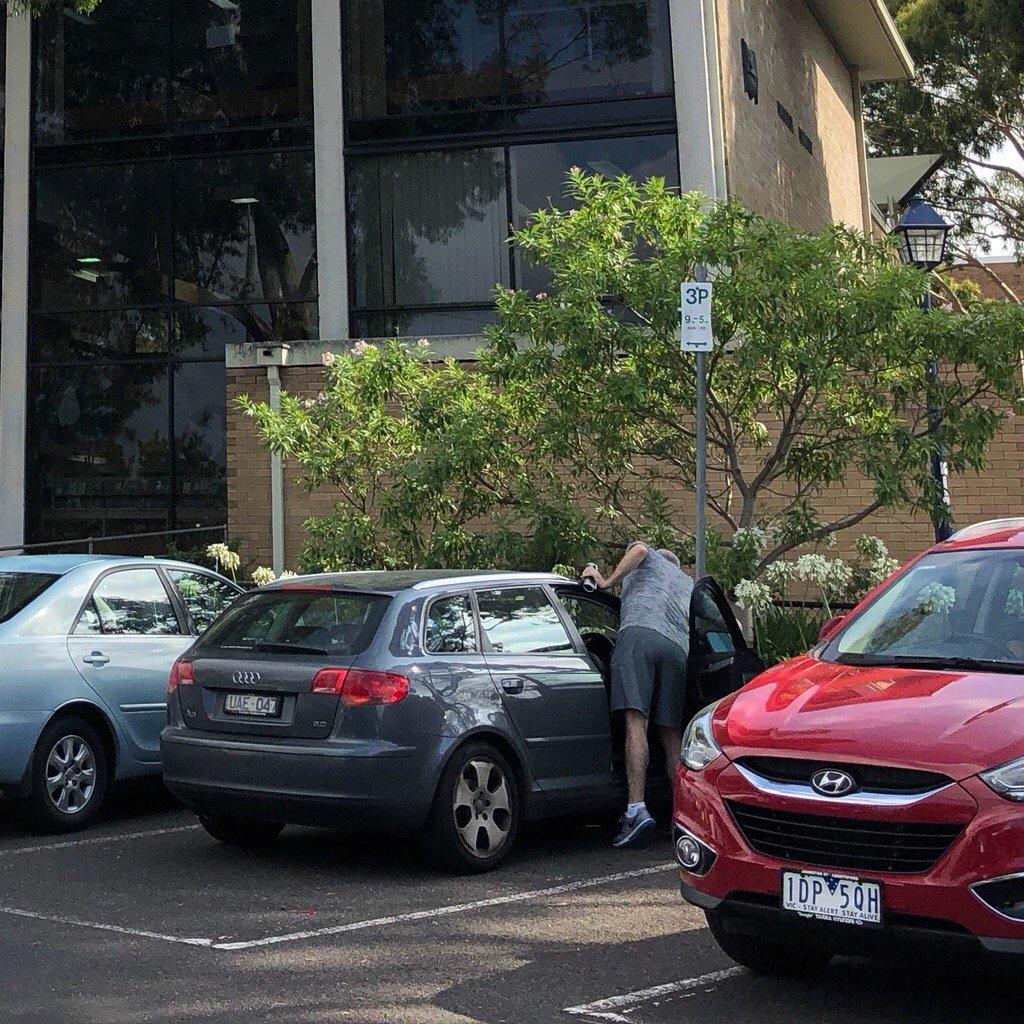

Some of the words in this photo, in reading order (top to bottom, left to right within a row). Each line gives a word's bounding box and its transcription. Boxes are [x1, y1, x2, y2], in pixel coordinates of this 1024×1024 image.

[686, 288, 709, 304] 3P
[788, 876, 823, 905] 1DP
[840, 883, 878, 913] 5QH
[803, 904, 818, 912] STAY
[842, 910, 857, 918] STAY
[860, 912, 878, 920] ALIVE
